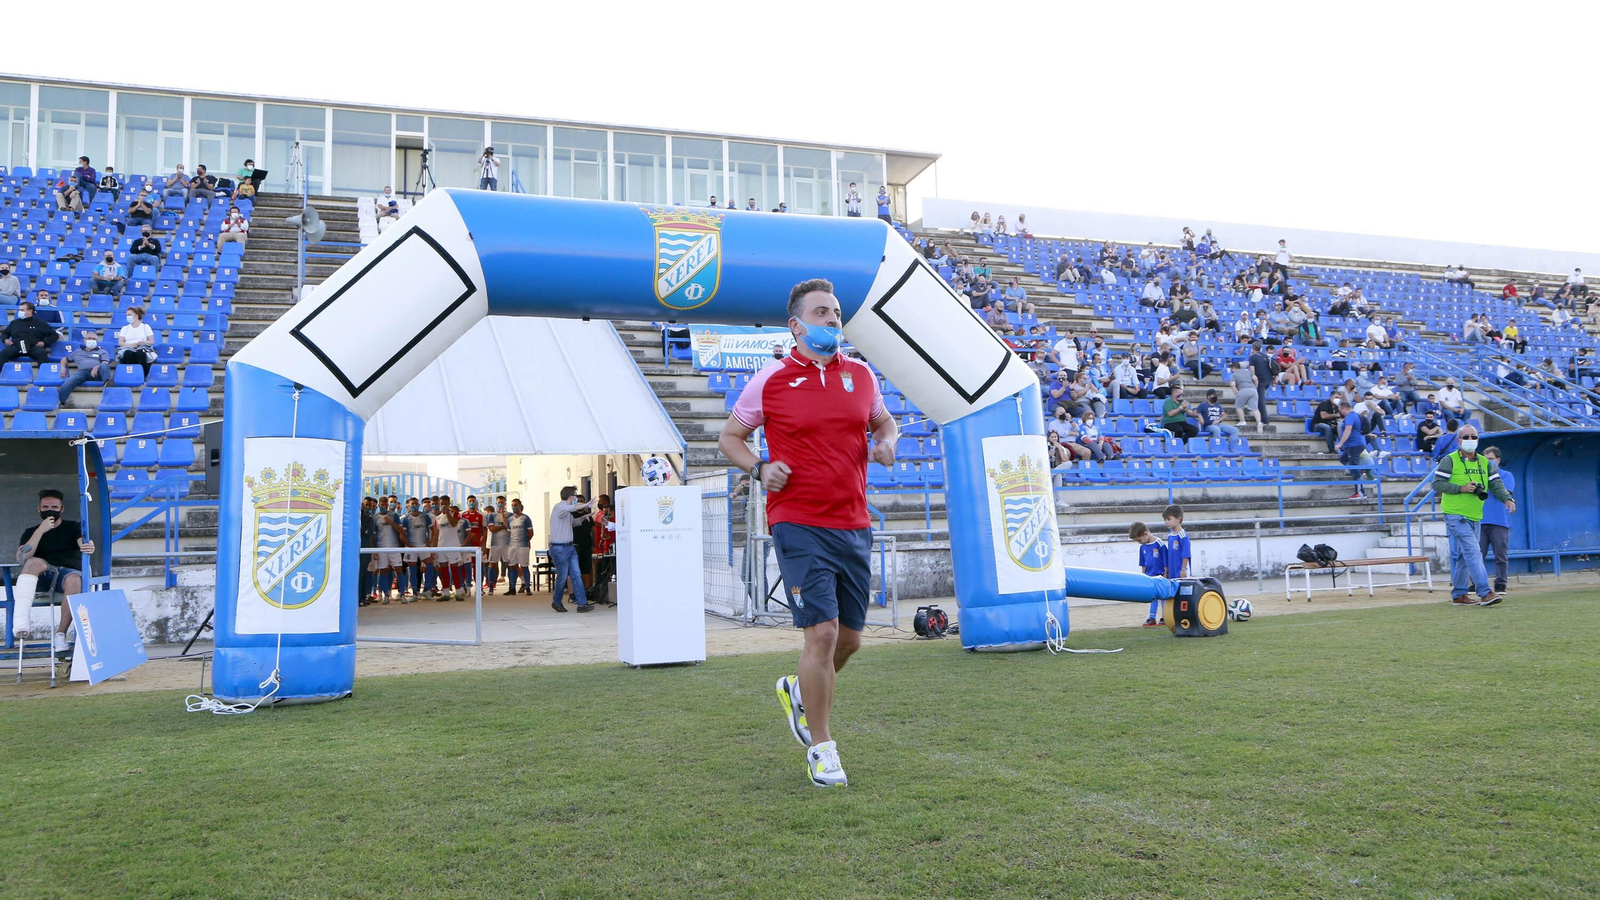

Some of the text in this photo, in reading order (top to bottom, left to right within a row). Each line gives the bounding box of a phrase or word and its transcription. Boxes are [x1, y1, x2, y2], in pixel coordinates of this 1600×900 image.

[664, 236, 715, 292] XEREZ
[264, 516, 324, 585] XEREZ
[1015, 499, 1047, 552] XEREZ
